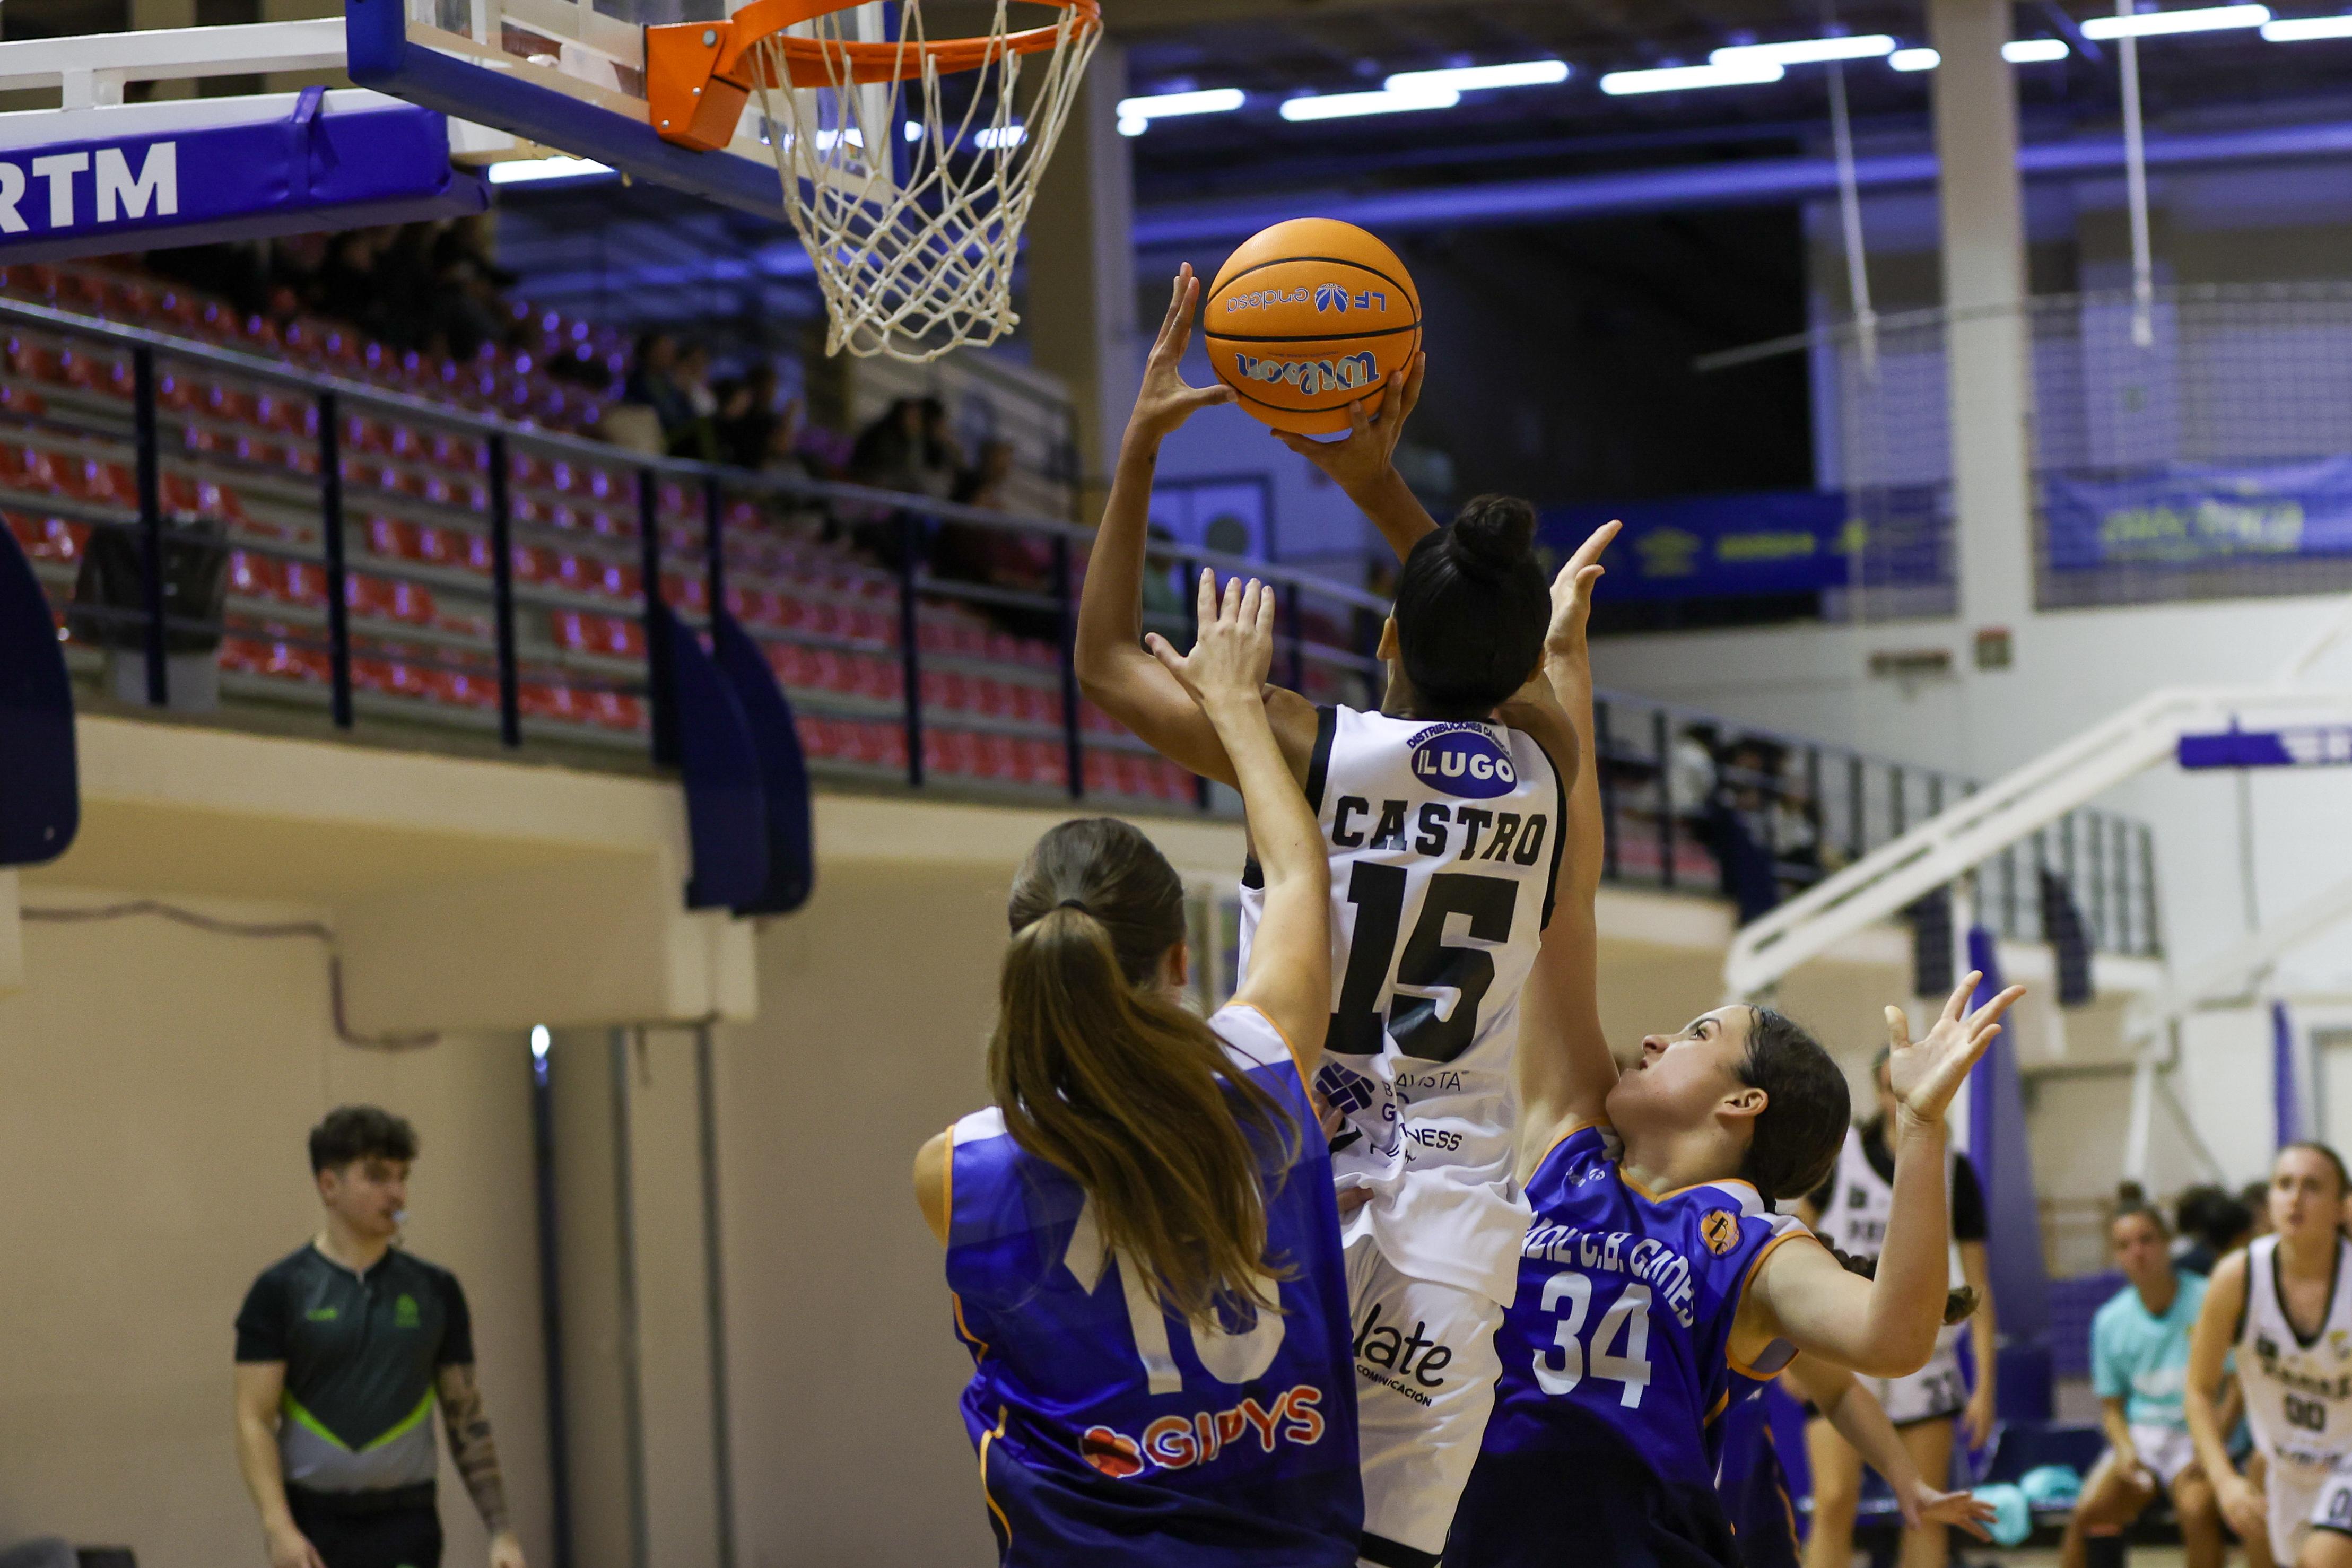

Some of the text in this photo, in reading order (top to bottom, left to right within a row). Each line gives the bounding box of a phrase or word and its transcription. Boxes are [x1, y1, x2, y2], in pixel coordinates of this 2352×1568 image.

[1226, 287, 1386, 313] LF endesa
[1235, 350, 1381, 396] Wilson
[1332, 795, 1548, 865] CASTRO
[1325, 860, 1520, 1063] 15
[1533, 1271, 1652, 1409] 34
